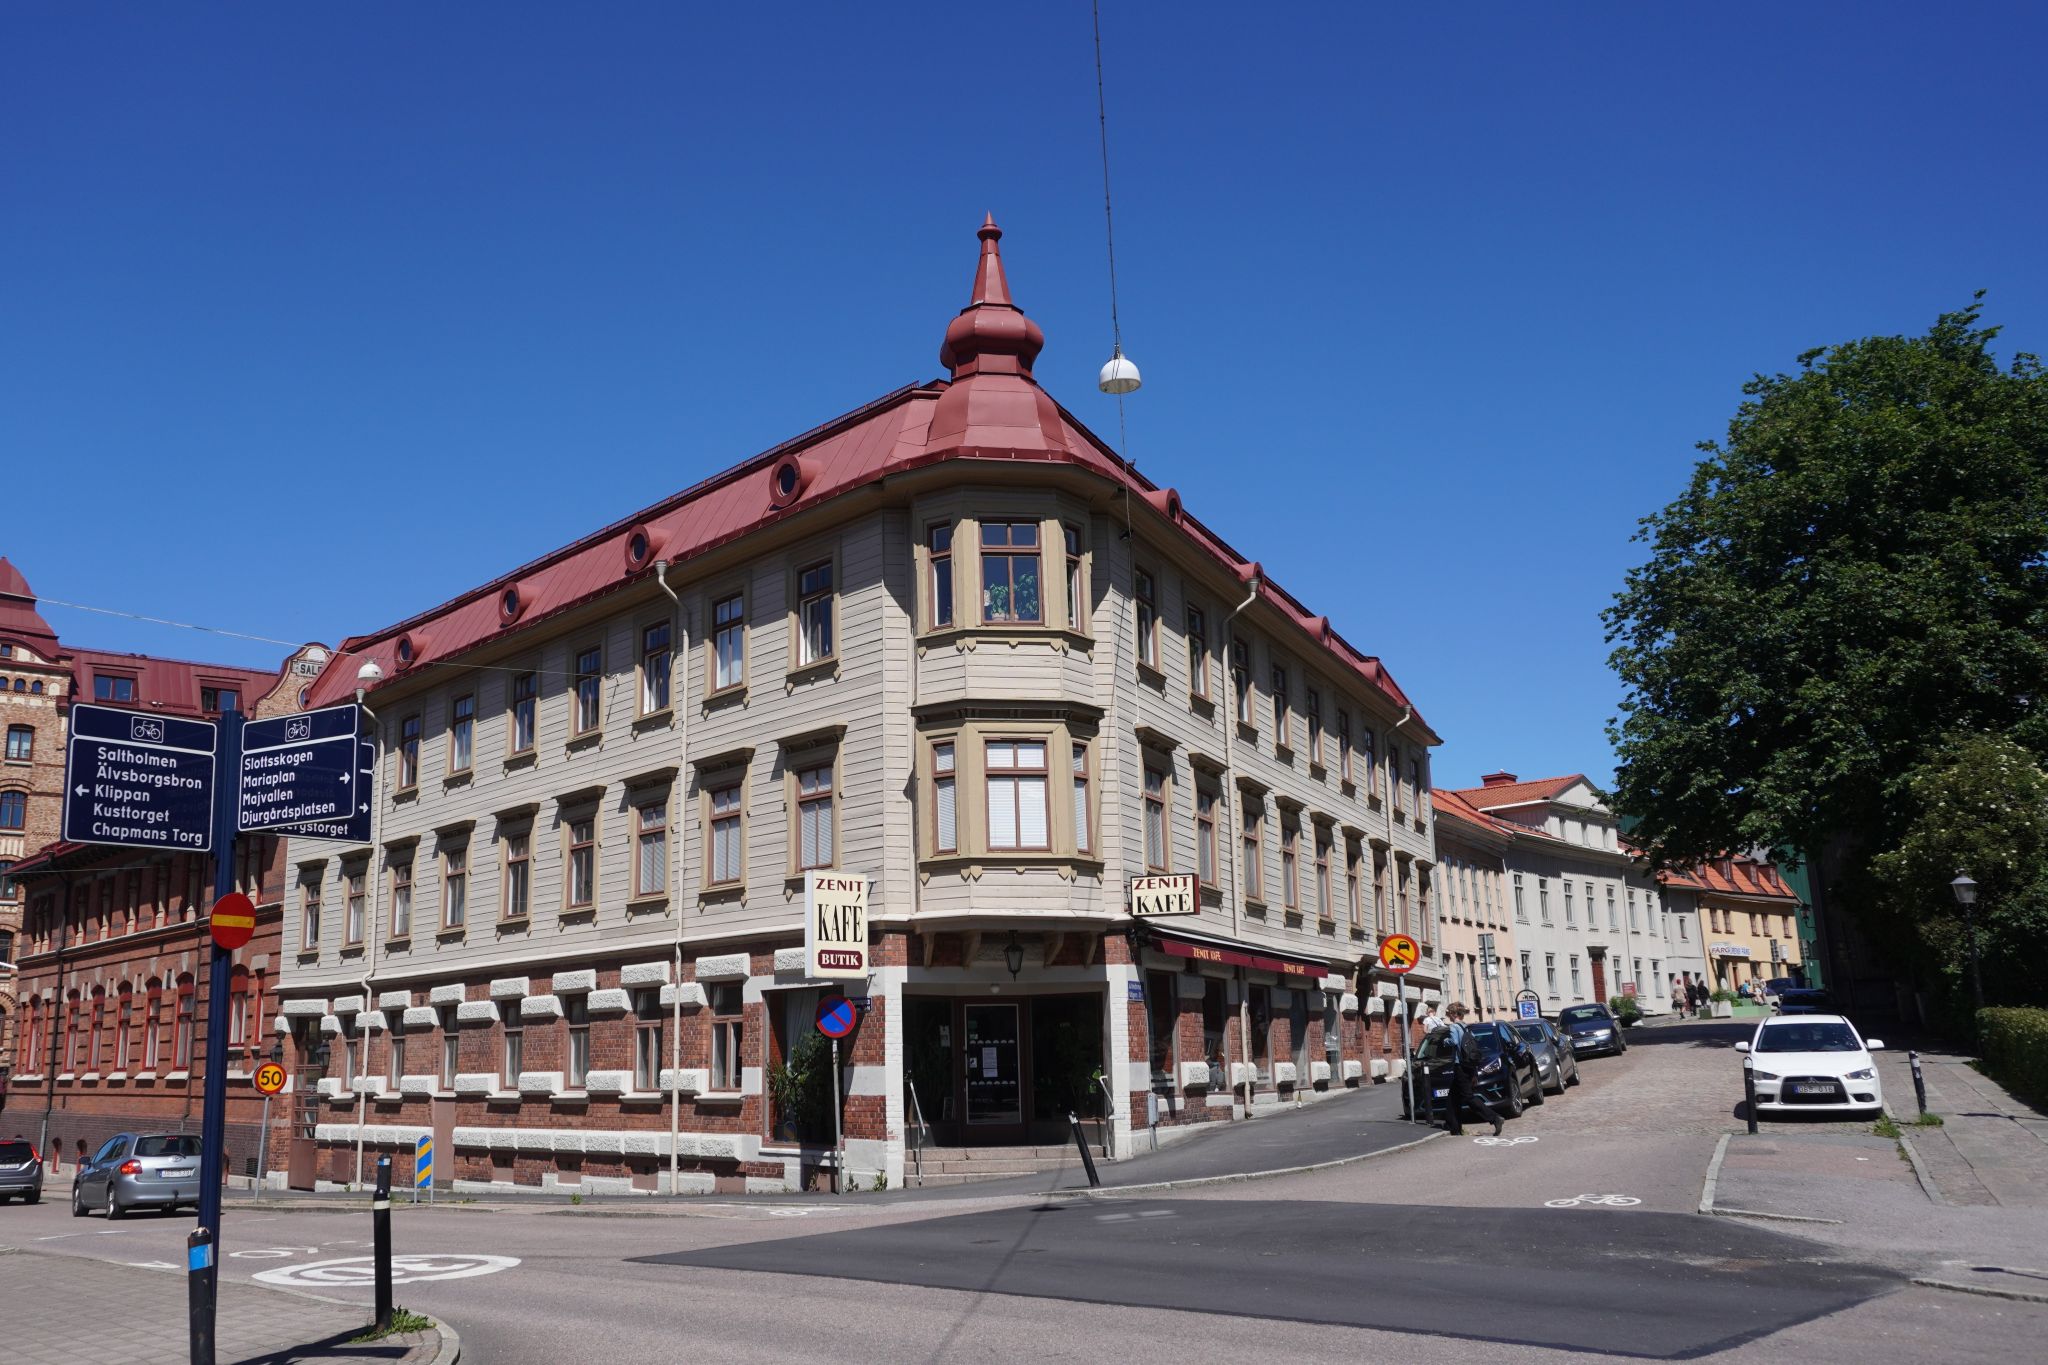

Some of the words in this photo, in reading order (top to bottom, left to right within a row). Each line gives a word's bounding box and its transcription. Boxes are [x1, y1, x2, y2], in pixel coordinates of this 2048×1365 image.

[97, 746, 177, 768] Saltholmen
[244, 751, 313, 770] Slottsskogen
[96, 762, 202, 789] Älvsborgsbron
[243, 771, 295, 788] Mariaplan
[94, 784, 150, 802] Klippan
[242, 789, 293, 807] Majvallen
[93, 803, 170, 824] Kusttorget
[242, 802, 335, 825] Djurgårdsplatsen
[92, 822, 168, 840] Chapmans
[172, 828, 203, 846] Torg
[815, 878, 863, 892] ZENIT
[1134, 876, 1191, 890] ZENIT
[1136, 887, 1191, 914] KAFÉ
[817, 893, 863, 943] KAFÉ
[821, 953, 859, 966] BUTIK
[1192, 947, 1209, 960] ZENIT
[261, 1071, 282, 1086] 50
